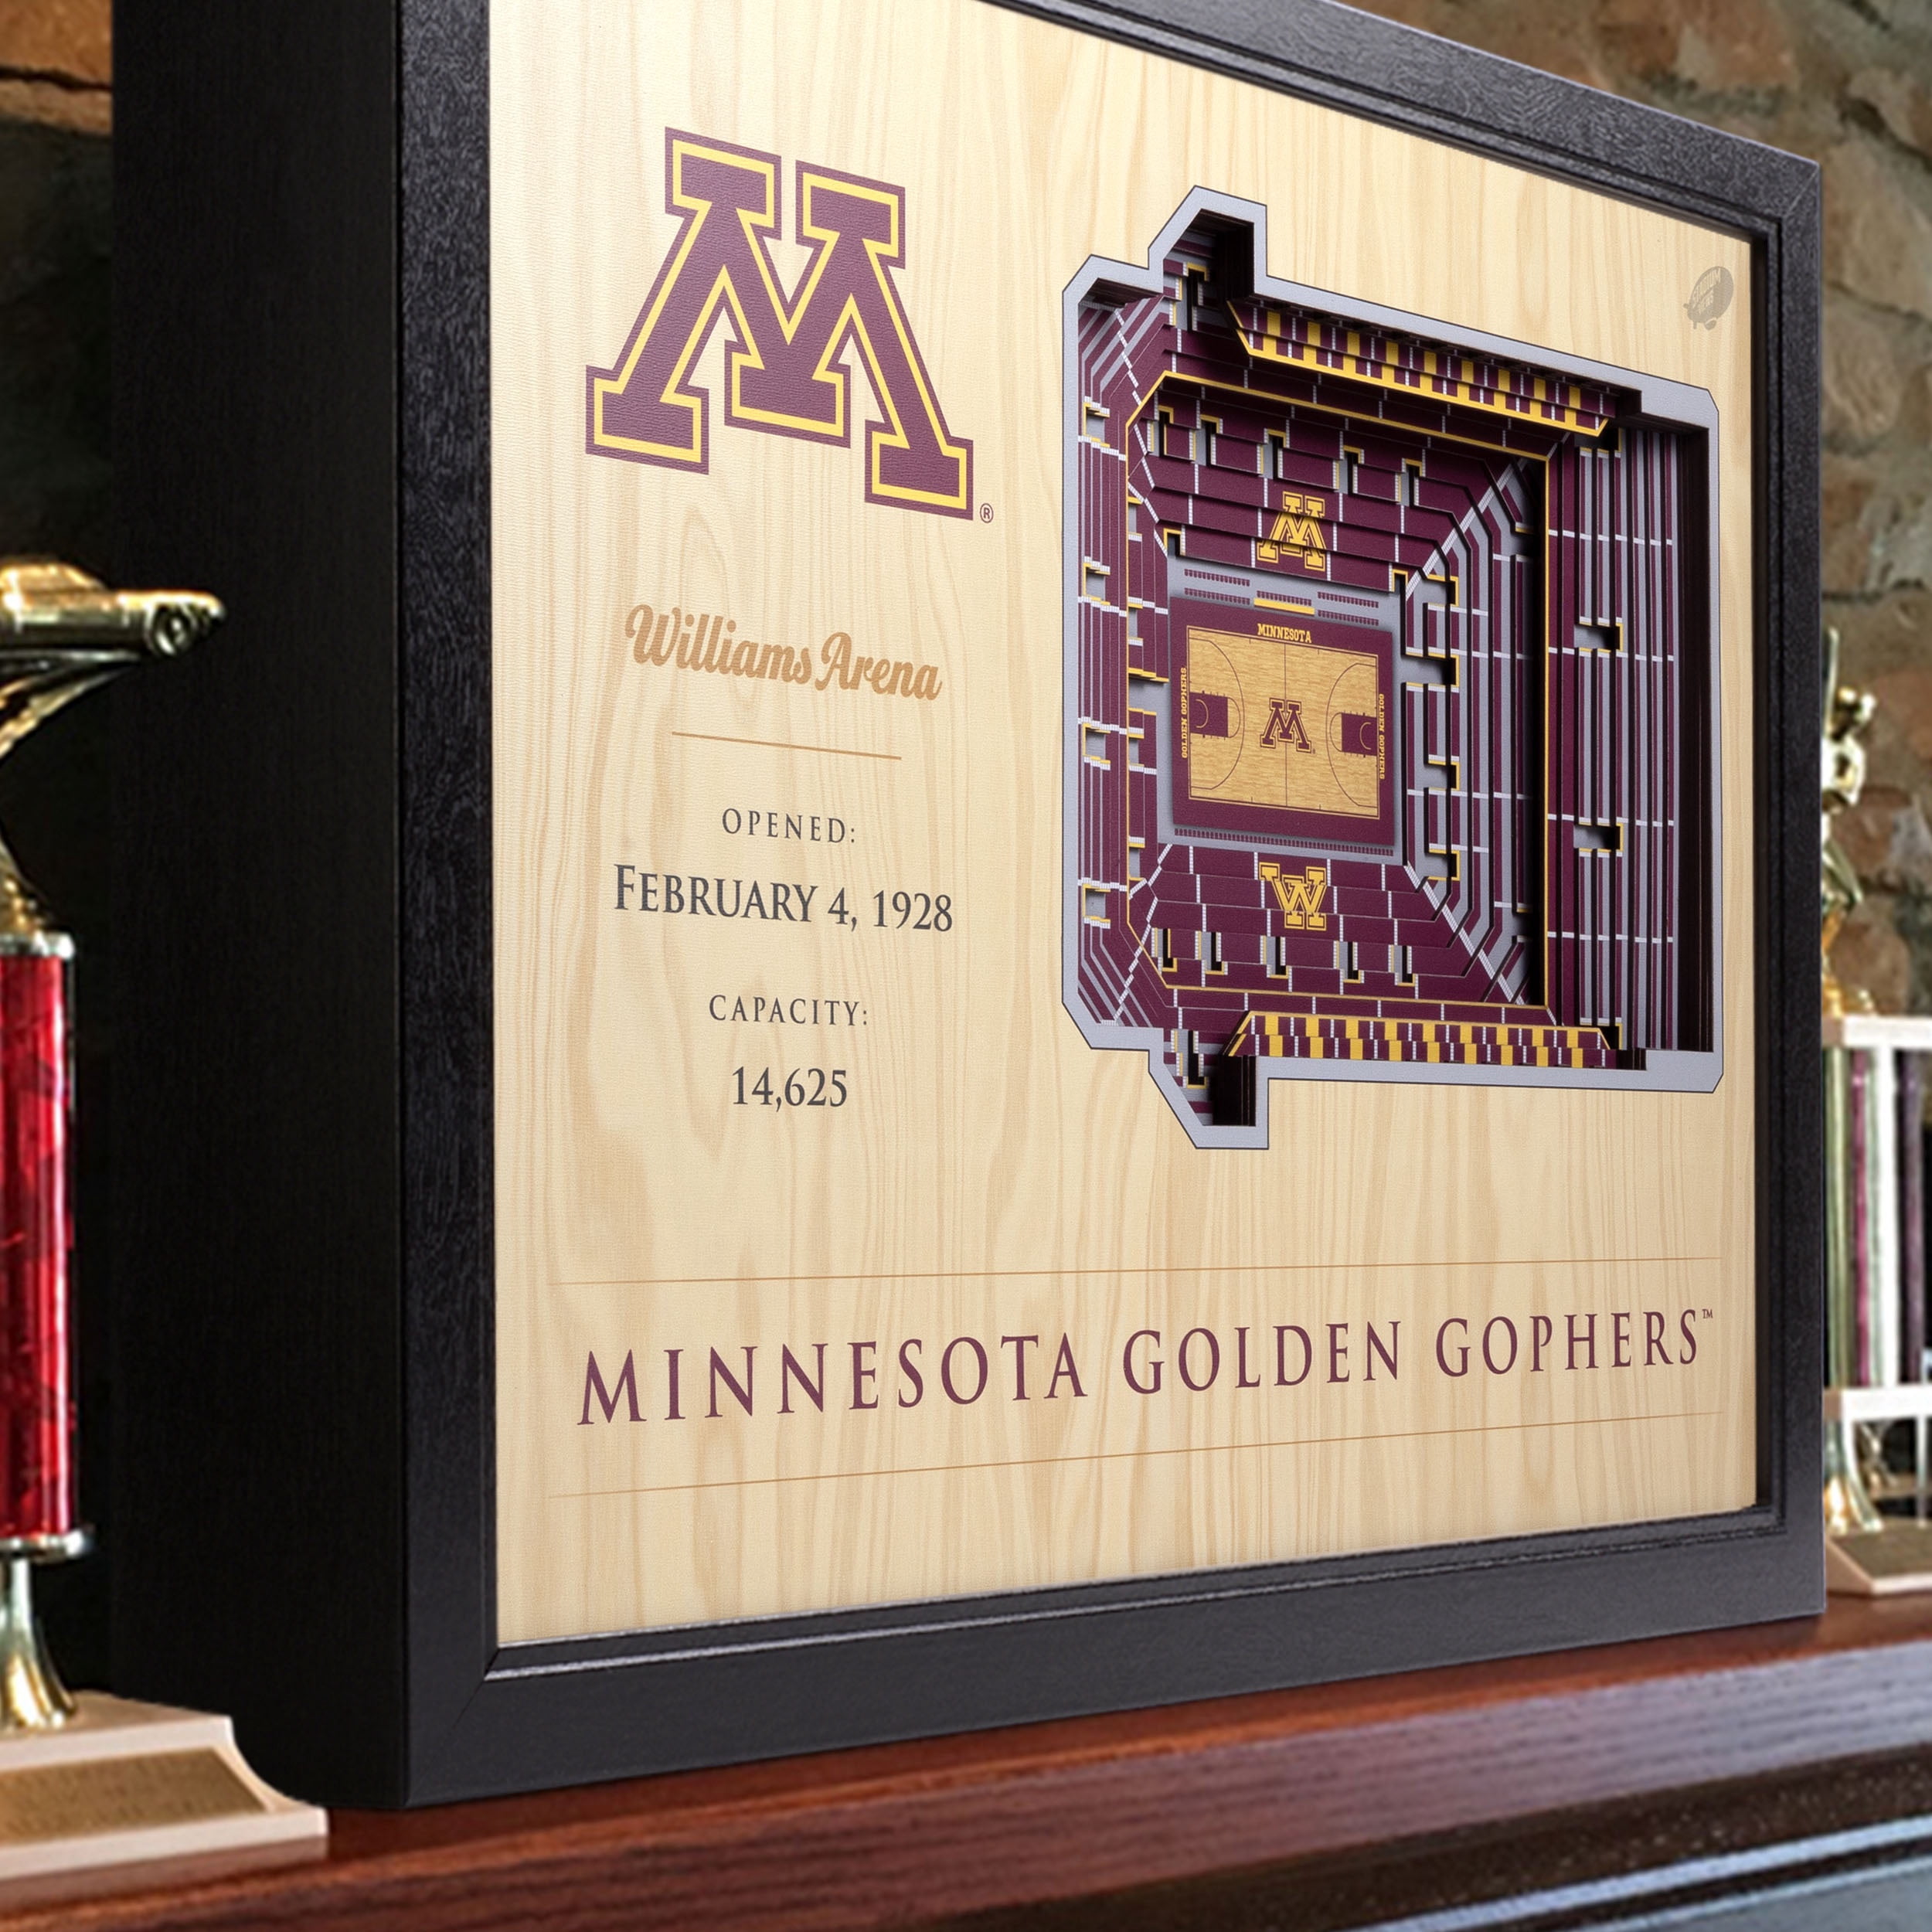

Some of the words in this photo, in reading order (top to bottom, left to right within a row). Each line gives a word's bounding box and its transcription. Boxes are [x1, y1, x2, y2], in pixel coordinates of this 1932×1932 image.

[624, 604, 812, 685] Williams
[815, 631, 943, 701] Arena
[1257, 622, 1312, 644] MINNESOTA
[722, 808, 855, 844] OPENED:
[614, 864, 818, 923] FEBRUARY
[828, 887, 858, 932] 4,
[872, 889, 954, 932] 1928
[709, 994, 869, 1026] CAPACITY:
[732, 1066, 848, 1113] 14,625
[577, 1332, 1089, 1427] MINNESOTA
[1122, 1320, 1402, 1395] GOLDEN
